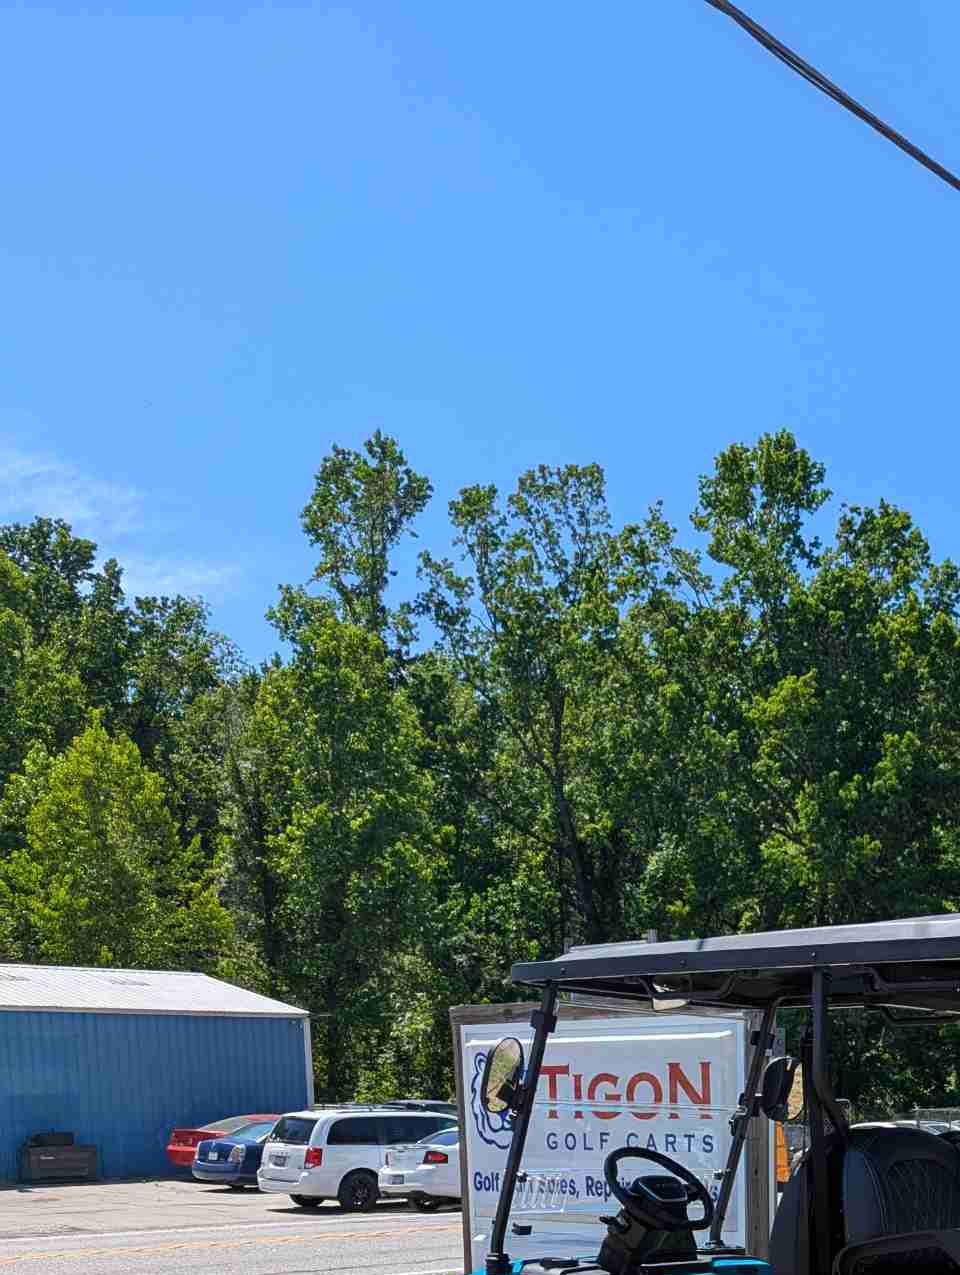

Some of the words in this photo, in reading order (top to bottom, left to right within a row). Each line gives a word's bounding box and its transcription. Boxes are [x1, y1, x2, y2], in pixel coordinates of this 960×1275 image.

[539, 1061, 713, 1120] TIGON
[546, 1132, 610, 1151] GOLF
[626, 1133, 714, 1153] CARTS
[473, 1171, 500, 1193] Golf
